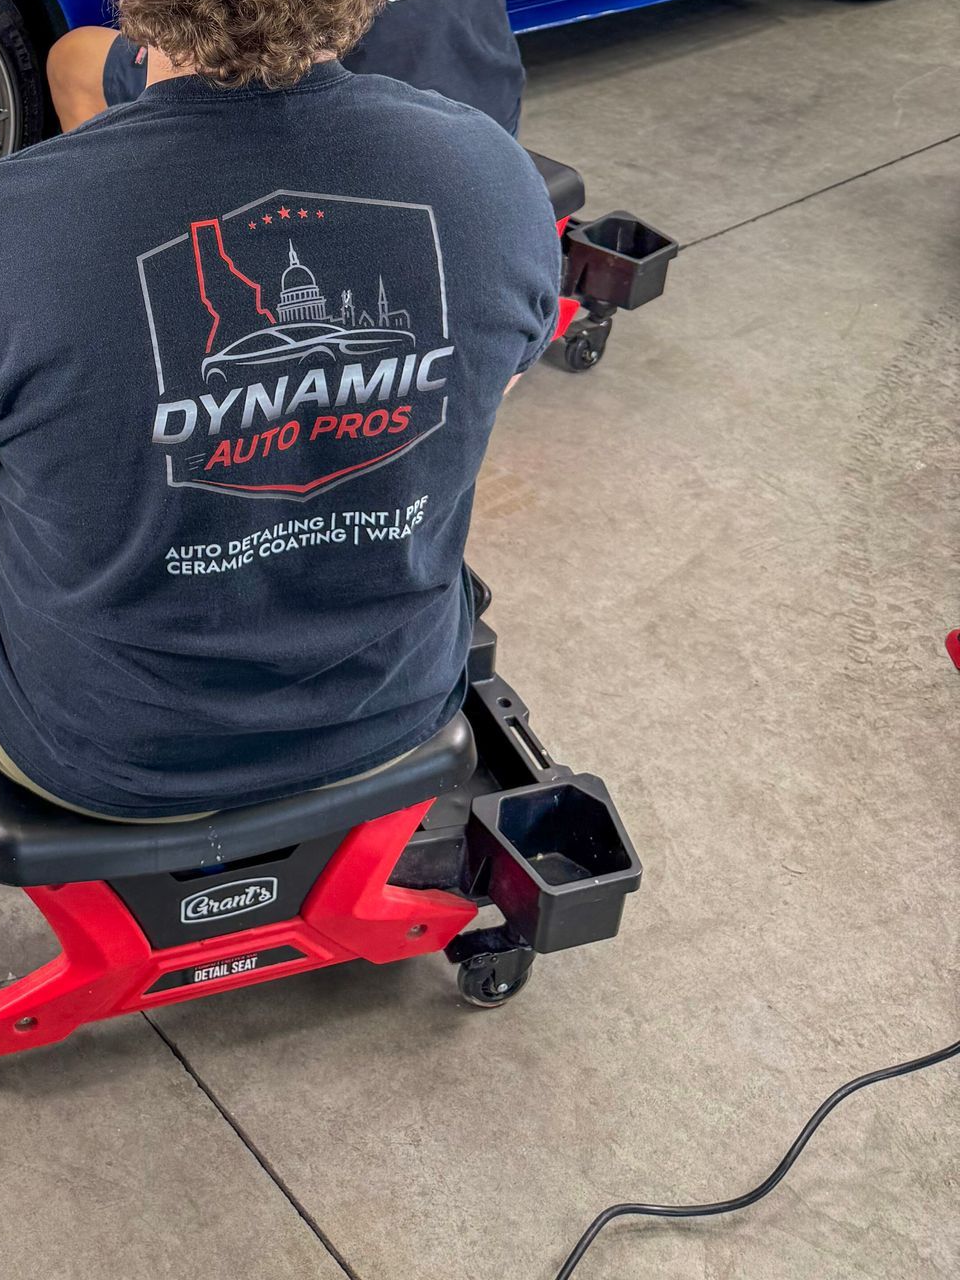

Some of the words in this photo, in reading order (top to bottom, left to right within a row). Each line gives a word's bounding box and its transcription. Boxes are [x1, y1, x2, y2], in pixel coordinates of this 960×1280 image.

[152, 345, 455, 444] DYNAMIC
[204, 420, 300, 470] AUTO
[310, 405, 413, 442] PROS
[165, 544, 222, 560] AUTO
[228, 517, 325, 555] DETAILING
[342, 511, 389, 526] TINT
[406, 495, 429, 521] PPF
[166, 549, 254, 575] CERAMIC
[258, 528, 347, 557] COATING
[366, 511, 425, 542] WRAS
[186, 885, 272, 918] Grant's
[194, 964, 230, 982] DETAIL
[231, 957, 258, 973] SEAT
